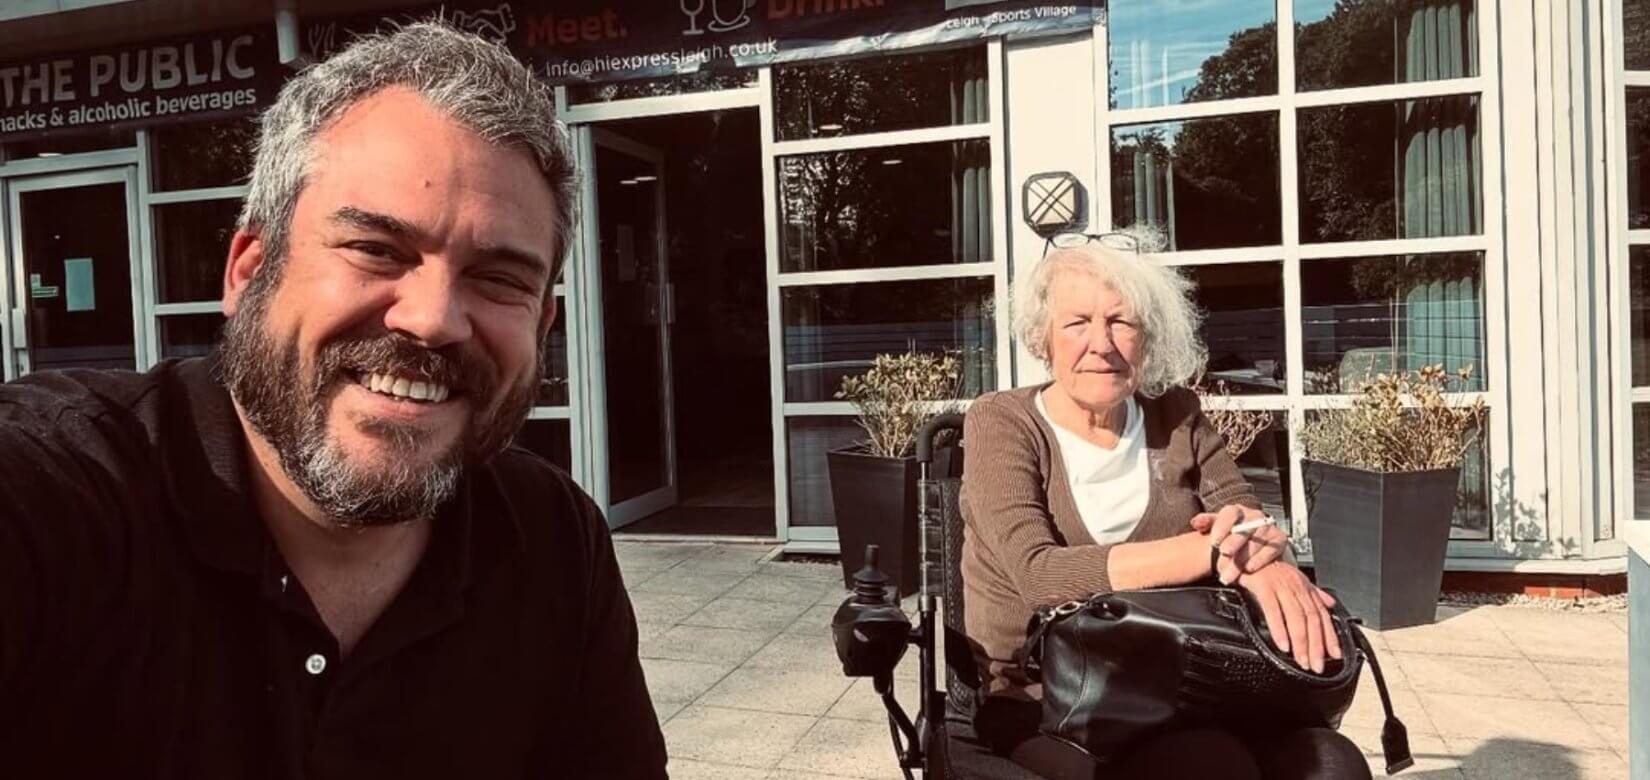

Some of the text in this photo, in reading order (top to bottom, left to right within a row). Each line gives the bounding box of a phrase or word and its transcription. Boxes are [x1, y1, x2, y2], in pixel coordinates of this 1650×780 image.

[527, 9, 627, 47] Meet.
[991, 9, 1031, 23] Sports
[1034, 5, 1077, 18] Village
[0, 36, 255, 108] THE PUBLIC
[50, 107, 64, 126] &
[68, 98, 150, 125] alcoholic
[156, 88, 256, 115] beverages
